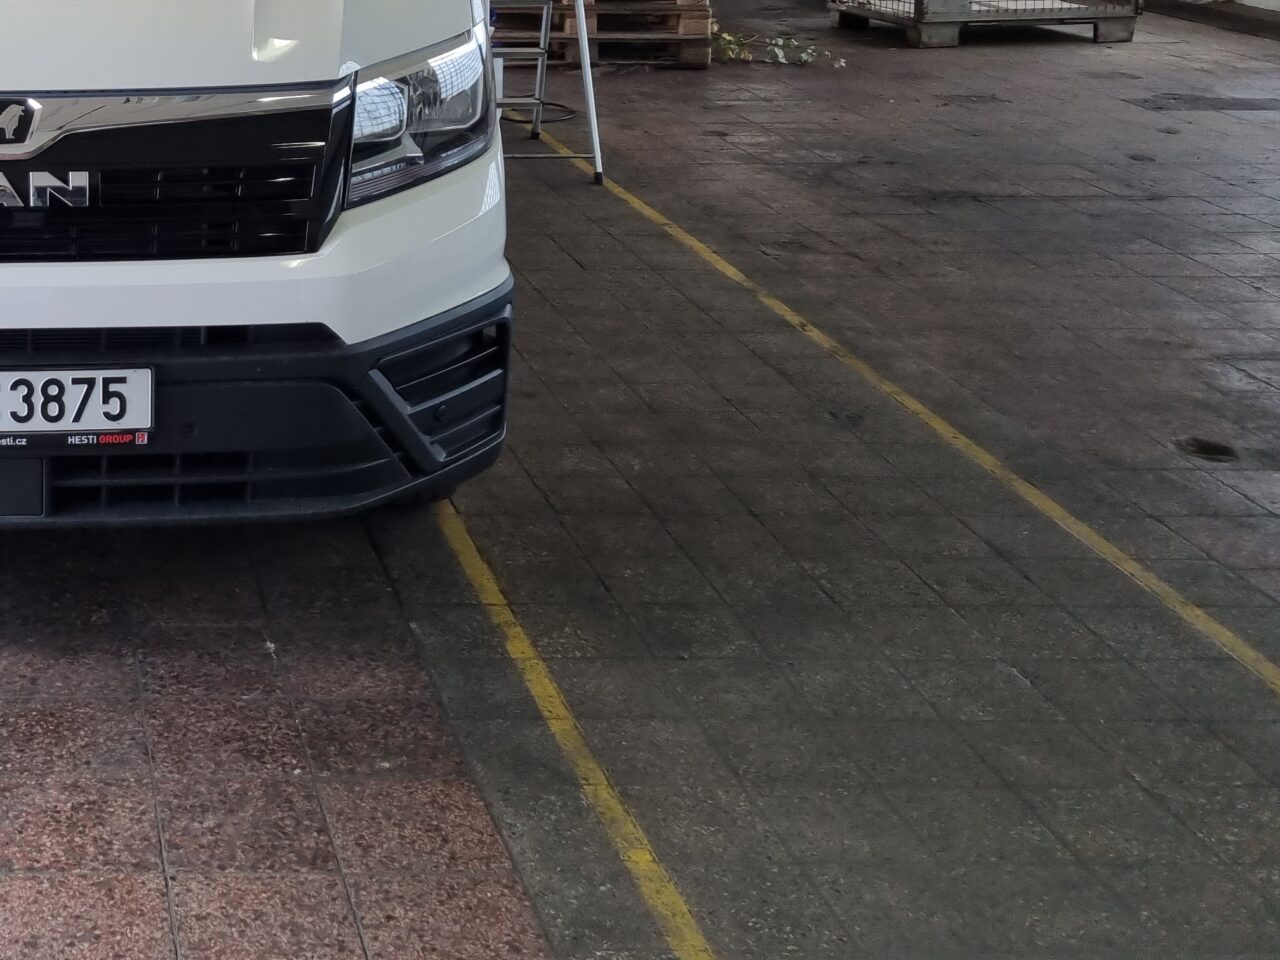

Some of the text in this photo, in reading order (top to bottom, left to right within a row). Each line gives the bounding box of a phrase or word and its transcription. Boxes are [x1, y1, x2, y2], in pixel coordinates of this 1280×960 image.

[9, 376, 127, 423] 3875
[68, 435, 132, 444] HESTI GROUP
